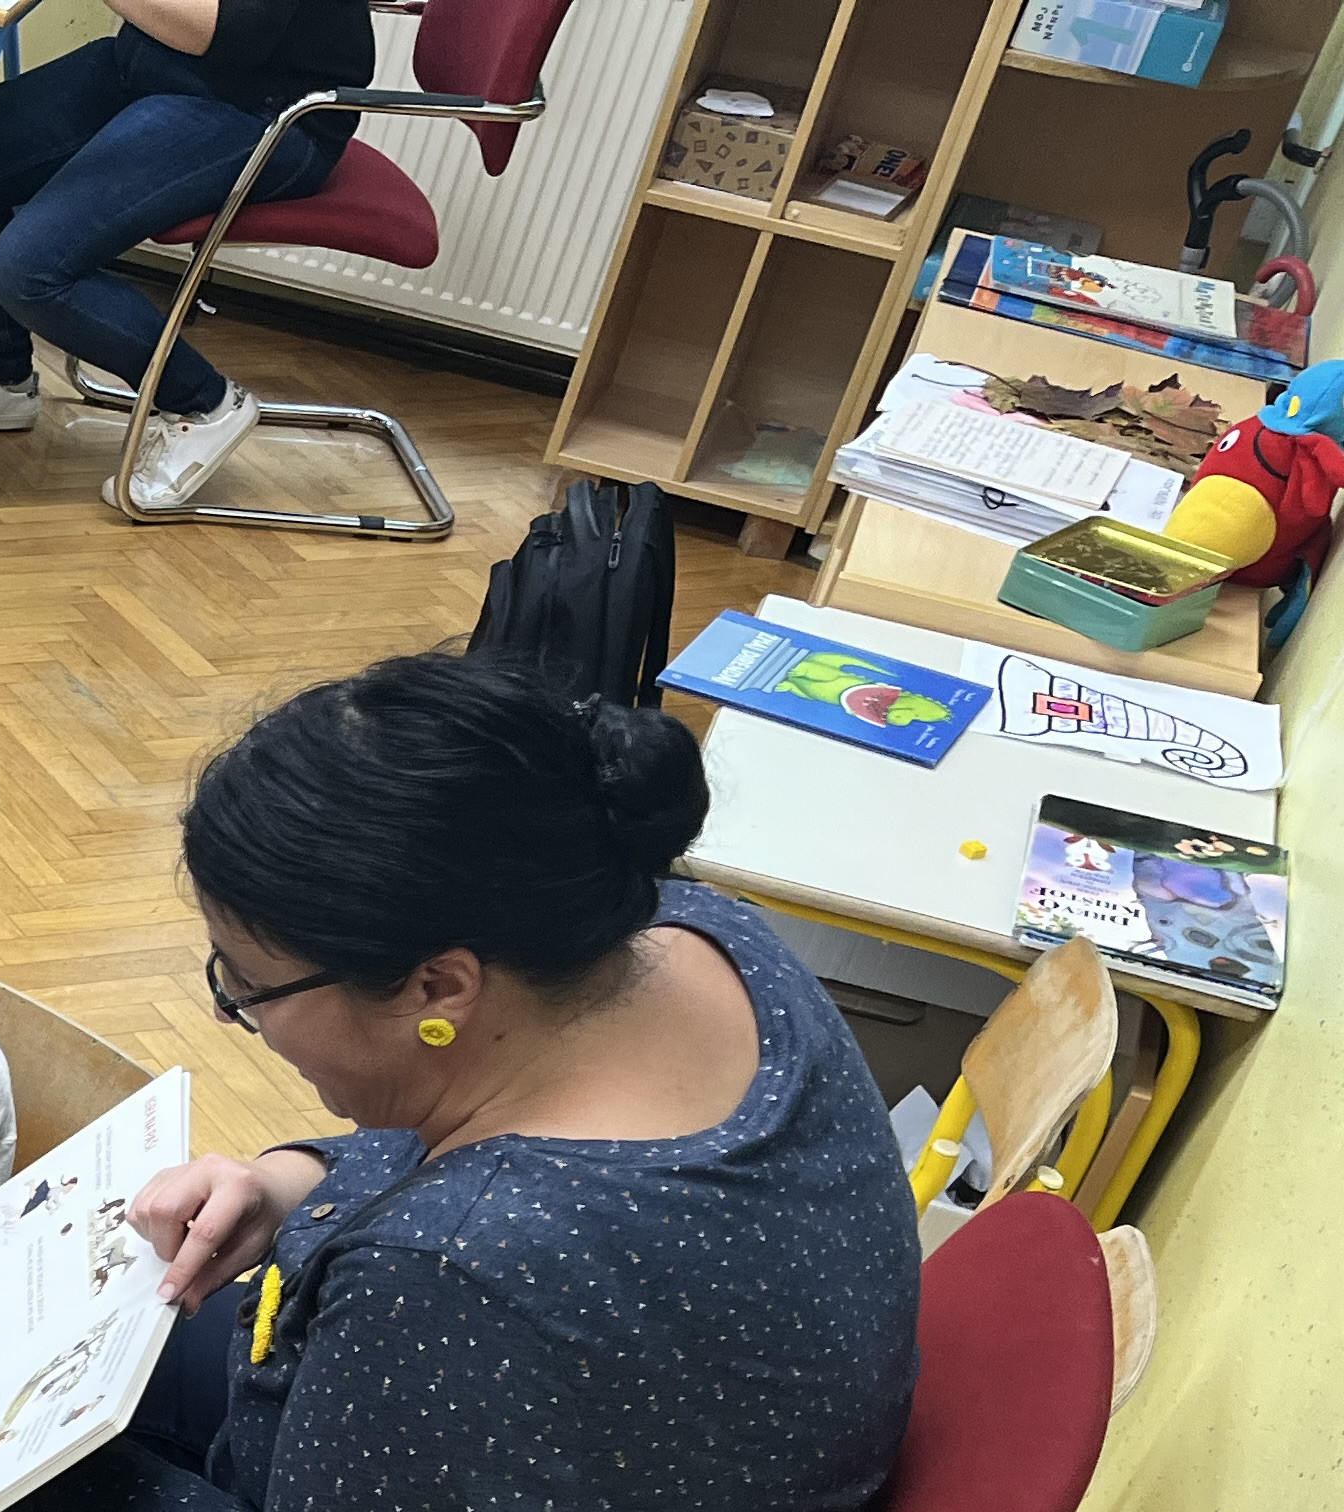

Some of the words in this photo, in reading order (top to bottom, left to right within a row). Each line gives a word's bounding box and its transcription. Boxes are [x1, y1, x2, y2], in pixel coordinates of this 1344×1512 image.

[1031, 6, 1049, 32] MOJ
[743, 631, 784, 653] ZMAJ
[1038, 898, 1130, 926] DREVO
